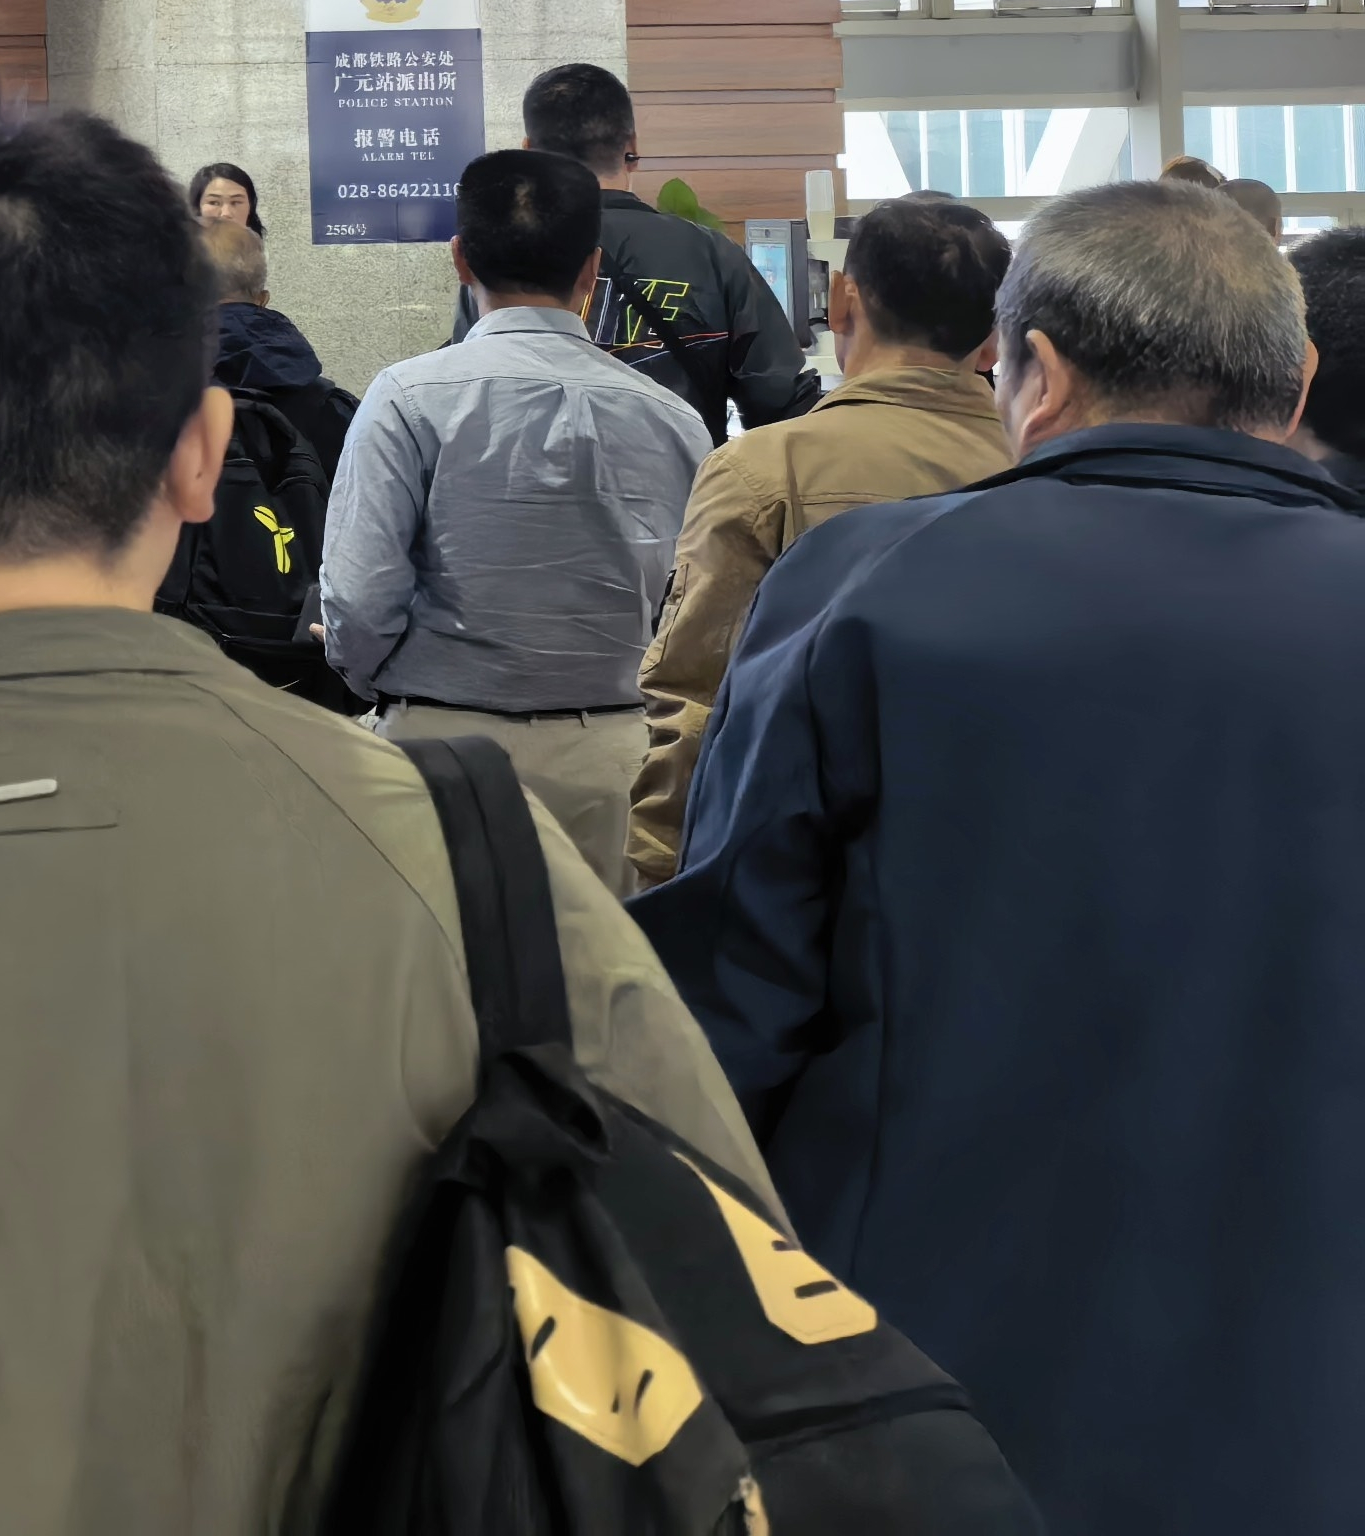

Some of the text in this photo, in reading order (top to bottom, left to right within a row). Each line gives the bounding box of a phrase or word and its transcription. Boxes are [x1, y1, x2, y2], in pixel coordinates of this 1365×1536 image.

[334, 50, 454, 69] 成都铁路公安处
[333, 71, 457, 93] 广元站派出所
[338, 96, 454, 108] POLICE STATION
[354, 127, 441, 149] 报警电话
[361, 151, 435, 162] ALARM TEL
[325, 222, 367, 236] 2556号
